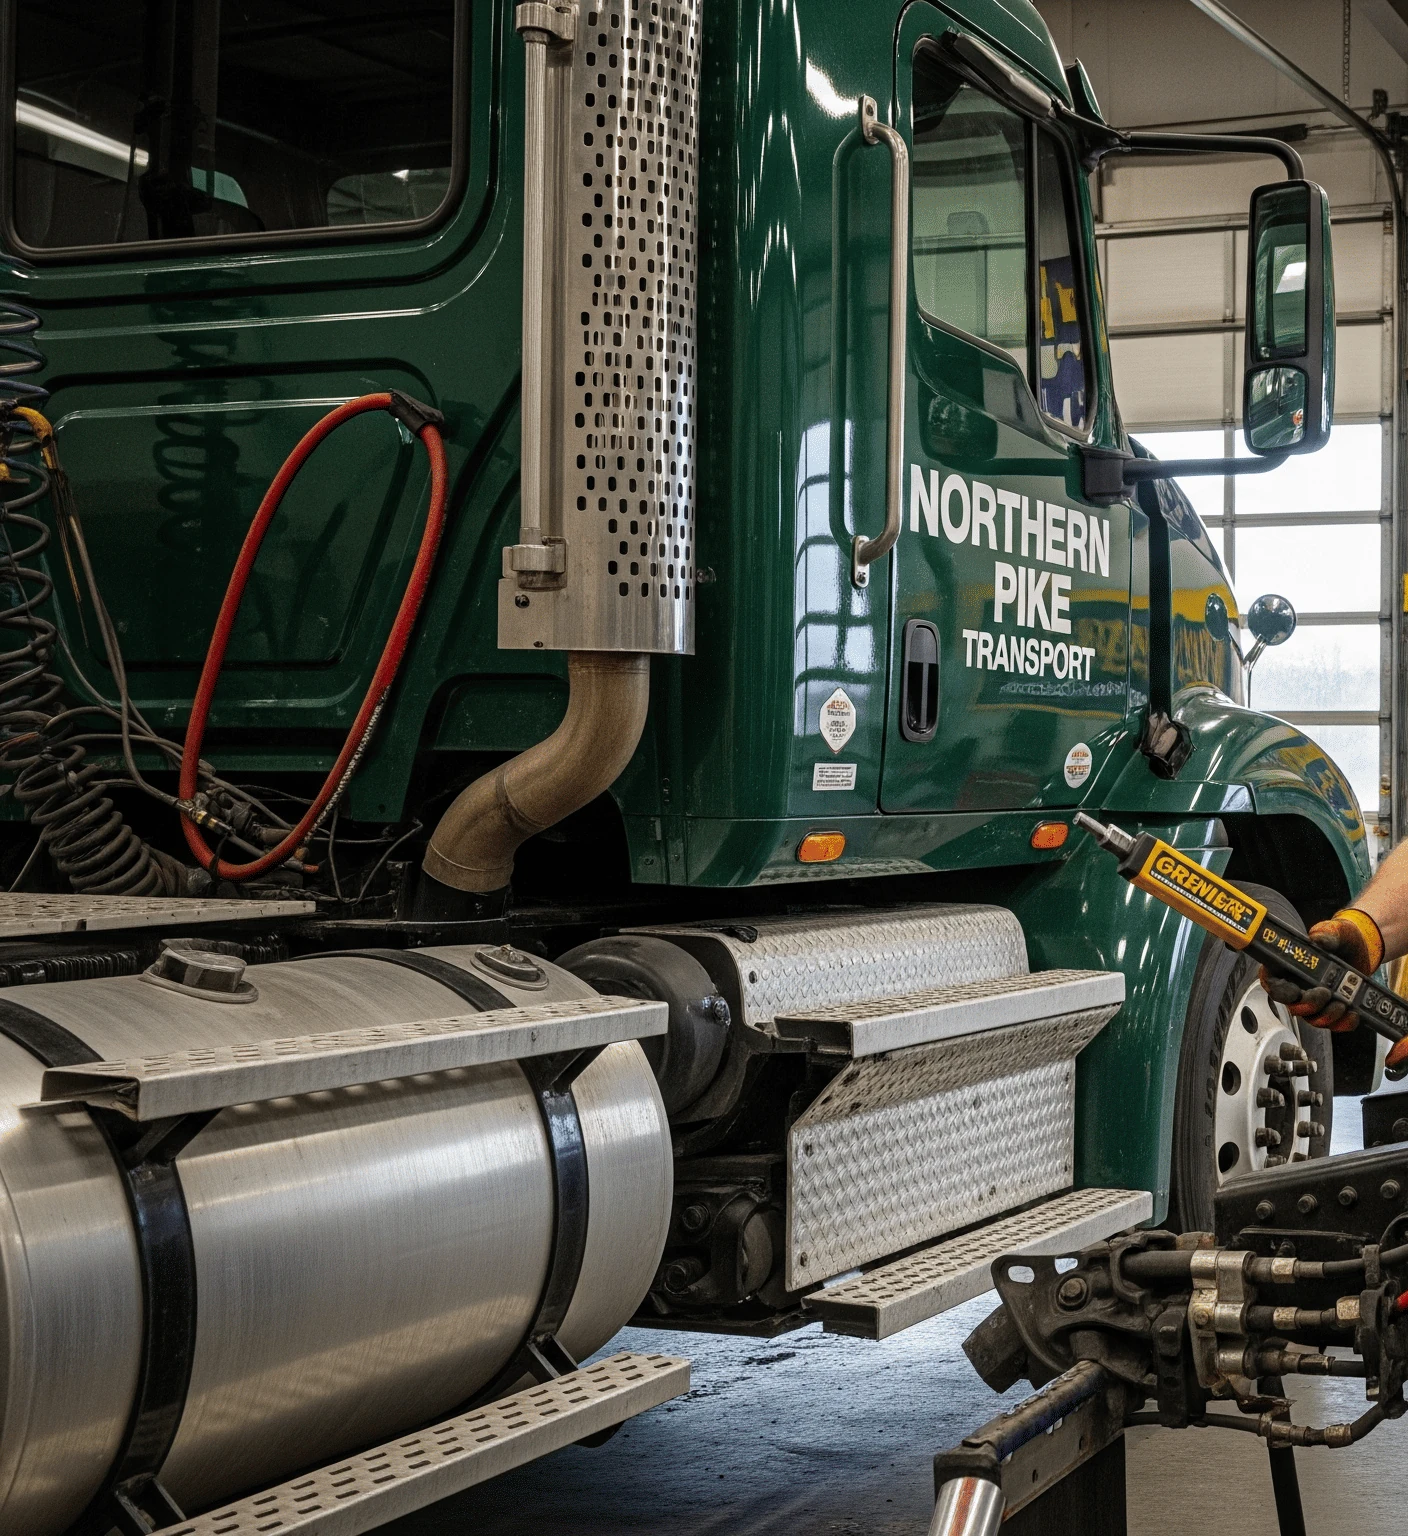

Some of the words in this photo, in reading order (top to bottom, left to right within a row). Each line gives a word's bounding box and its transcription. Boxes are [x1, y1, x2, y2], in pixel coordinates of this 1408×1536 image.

[909, 464, 1110, 578] NORTHERN
[993, 561, 1072, 635] PIKE
[962, 628, 1096, 682] TRANSPORT
